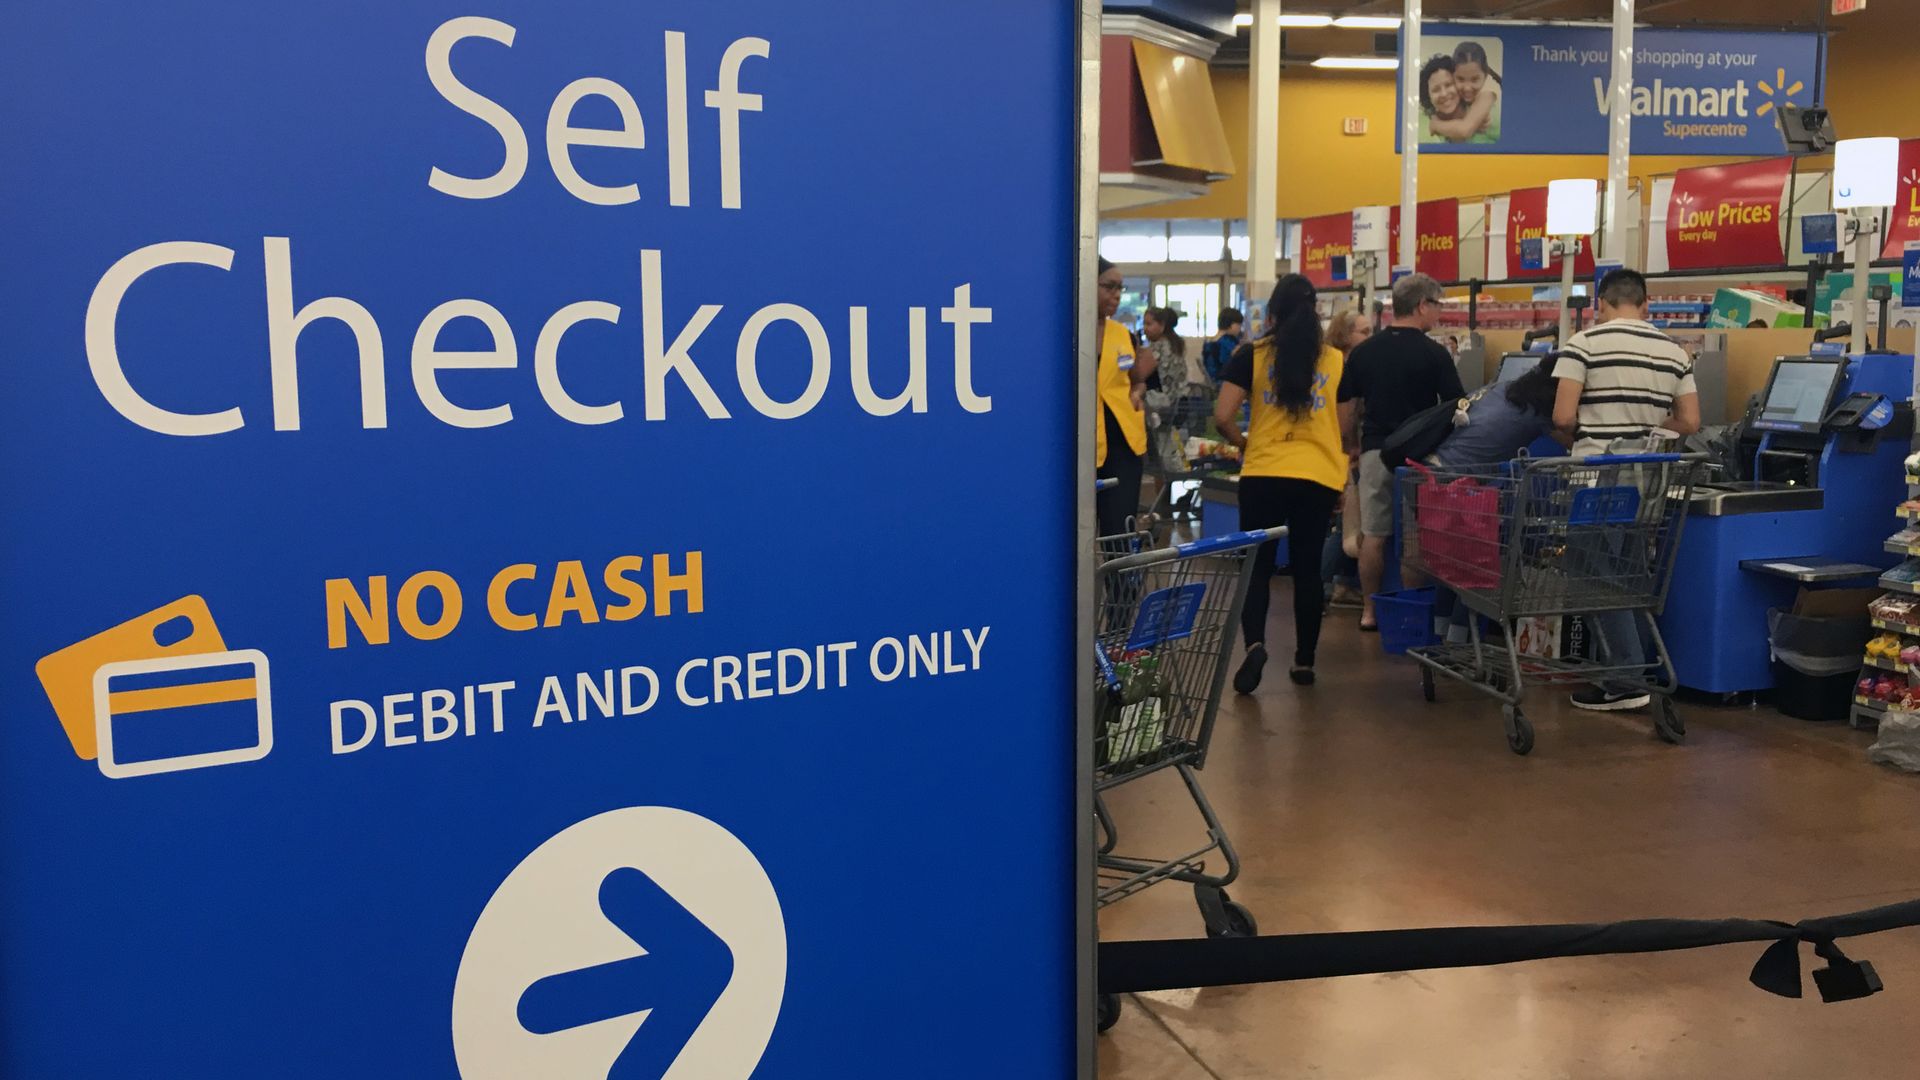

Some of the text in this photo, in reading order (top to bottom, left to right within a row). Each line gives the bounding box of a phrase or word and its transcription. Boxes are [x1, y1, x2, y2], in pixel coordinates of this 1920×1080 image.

[1531, 45, 1758, 69] Thank you shopping at your
[425, 16, 770, 209] Self
[1663, 120, 1747, 139] Supercentre
[1679, 200, 1772, 229] Low Prices
[1420, 232, 1454, 251] Prices
[1678, 228, 1717, 243] Every day
[1306, 245, 1324, 262] Low
[84, 237, 993, 436] Checkout
[325, 550, 704, 649] NO CASH
[1569, 615, 1583, 656] FRESH
[329, 626, 991, 755] DEBIT AND CREDIT ONLY
